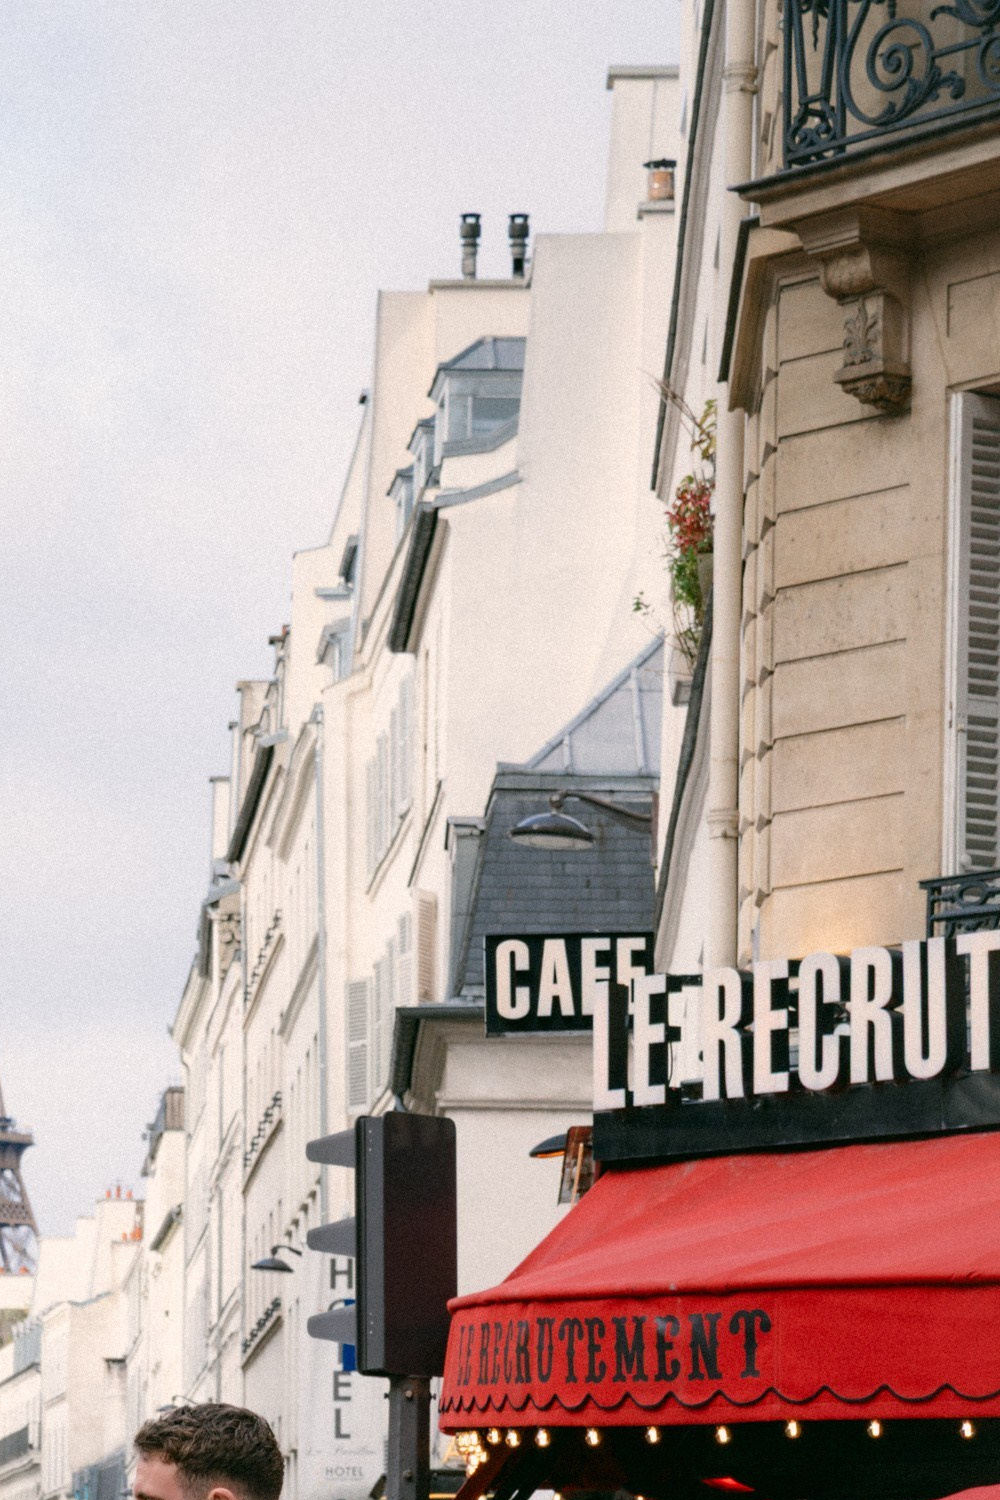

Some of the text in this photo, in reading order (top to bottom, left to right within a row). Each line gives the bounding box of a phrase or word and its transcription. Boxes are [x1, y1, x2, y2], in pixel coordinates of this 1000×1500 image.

[592, 973, 666, 1110] LE
[327, 1258, 355, 1439] HEL
[456, 1308, 772, 1387] LE RECRUTEMENT
[325, 1466, 364, 1477] HOTEL
